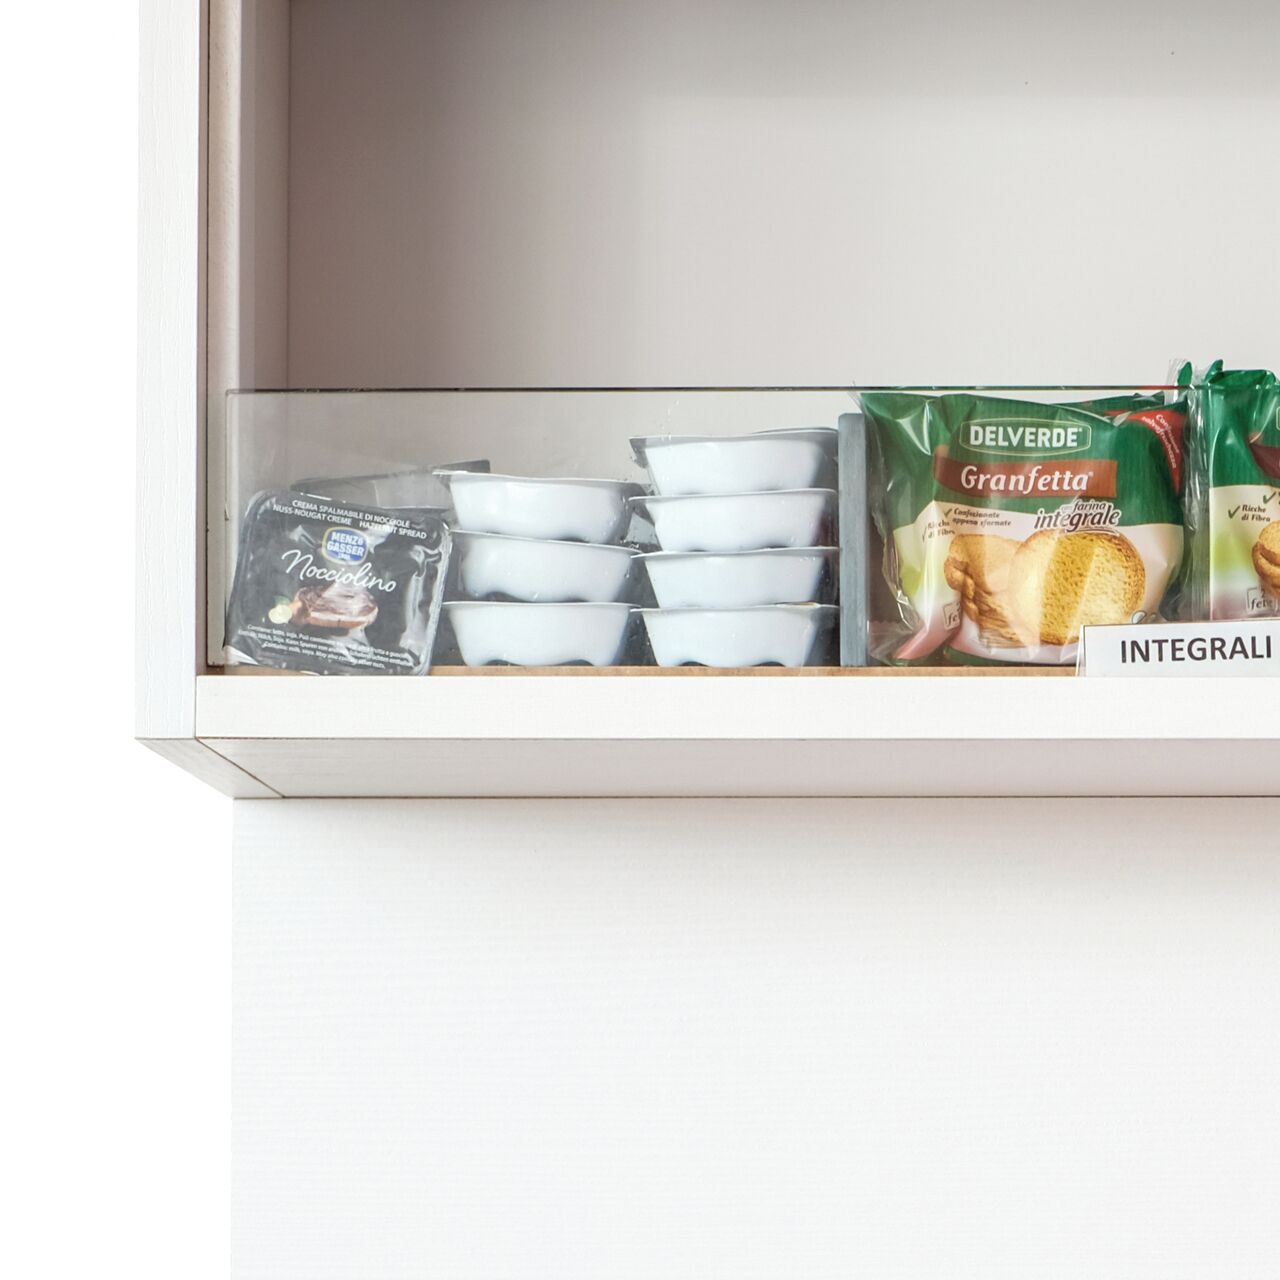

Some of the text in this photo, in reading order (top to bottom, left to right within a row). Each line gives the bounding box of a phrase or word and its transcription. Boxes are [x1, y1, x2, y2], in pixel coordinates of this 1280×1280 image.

[969, 425, 1080, 448] DELVERDE
[961, 465, 1089, 494] Granfetta
[292, 499, 318, 512] CREMA
[1073, 500, 1106, 513] farina
[327, 514, 353, 525] CREME
[1034, 504, 1121, 533] integrale
[398, 527, 427, 540] SPREAD
[327, 541, 365, 556] GASSER
[281, 549, 397, 593] Nocciolino
[1121, 635, 1272, 663] INTEGRALI
